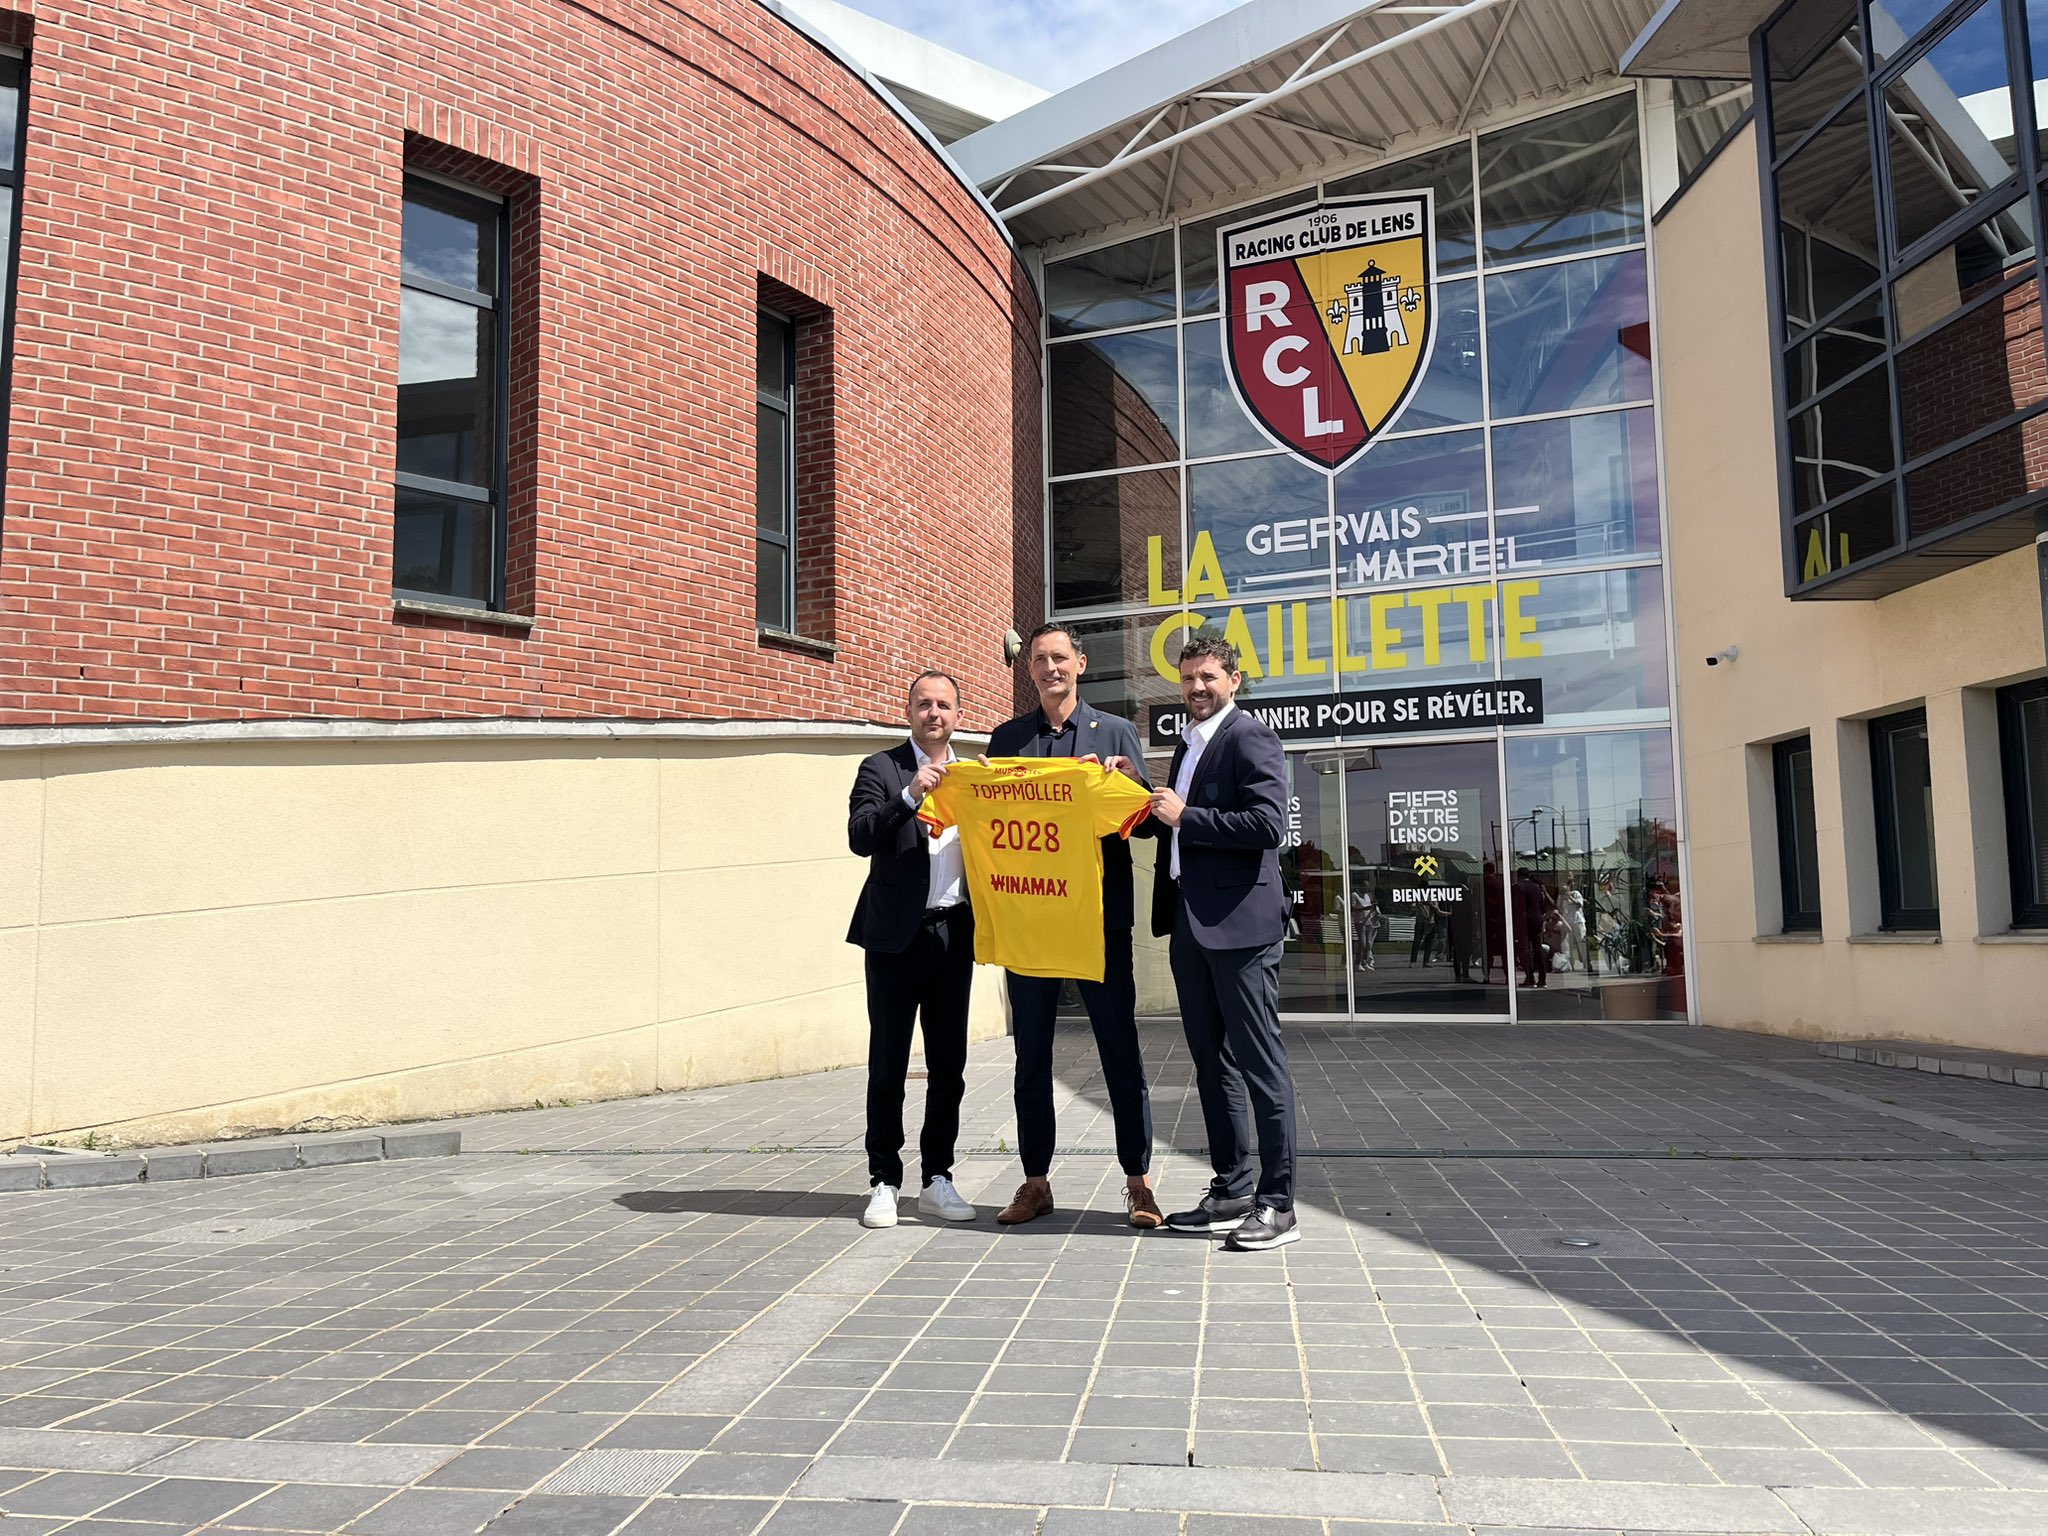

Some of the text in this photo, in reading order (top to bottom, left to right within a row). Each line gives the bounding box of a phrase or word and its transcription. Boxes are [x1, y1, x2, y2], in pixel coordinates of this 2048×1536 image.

[1308, 213, 1338, 228] 1906
[1235, 213, 1414, 261] RACING CLUB DE LENS
[1246, 506, 1422, 556] GERVAIS
[1147, 530, 1230, 606] LA
[1356, 536, 1543, 584] MARTEL
[1316, 698, 1386, 728] POUR
[1393, 697, 1422, 722] SE
[1428, 689, 1534, 722] RÉVÉLER.
[971, 781, 1072, 801] TOPPMÖLLER
[1389, 790, 1458, 808] FIERS
[1390, 807, 1459, 826] D'ÊTRE
[991, 819, 1060, 853] 2028
[1390, 826, 1460, 845] LENSOIS
[991, 874, 1068, 897] WINAMAX
[1393, 888, 1463, 903] BIENVENUE
